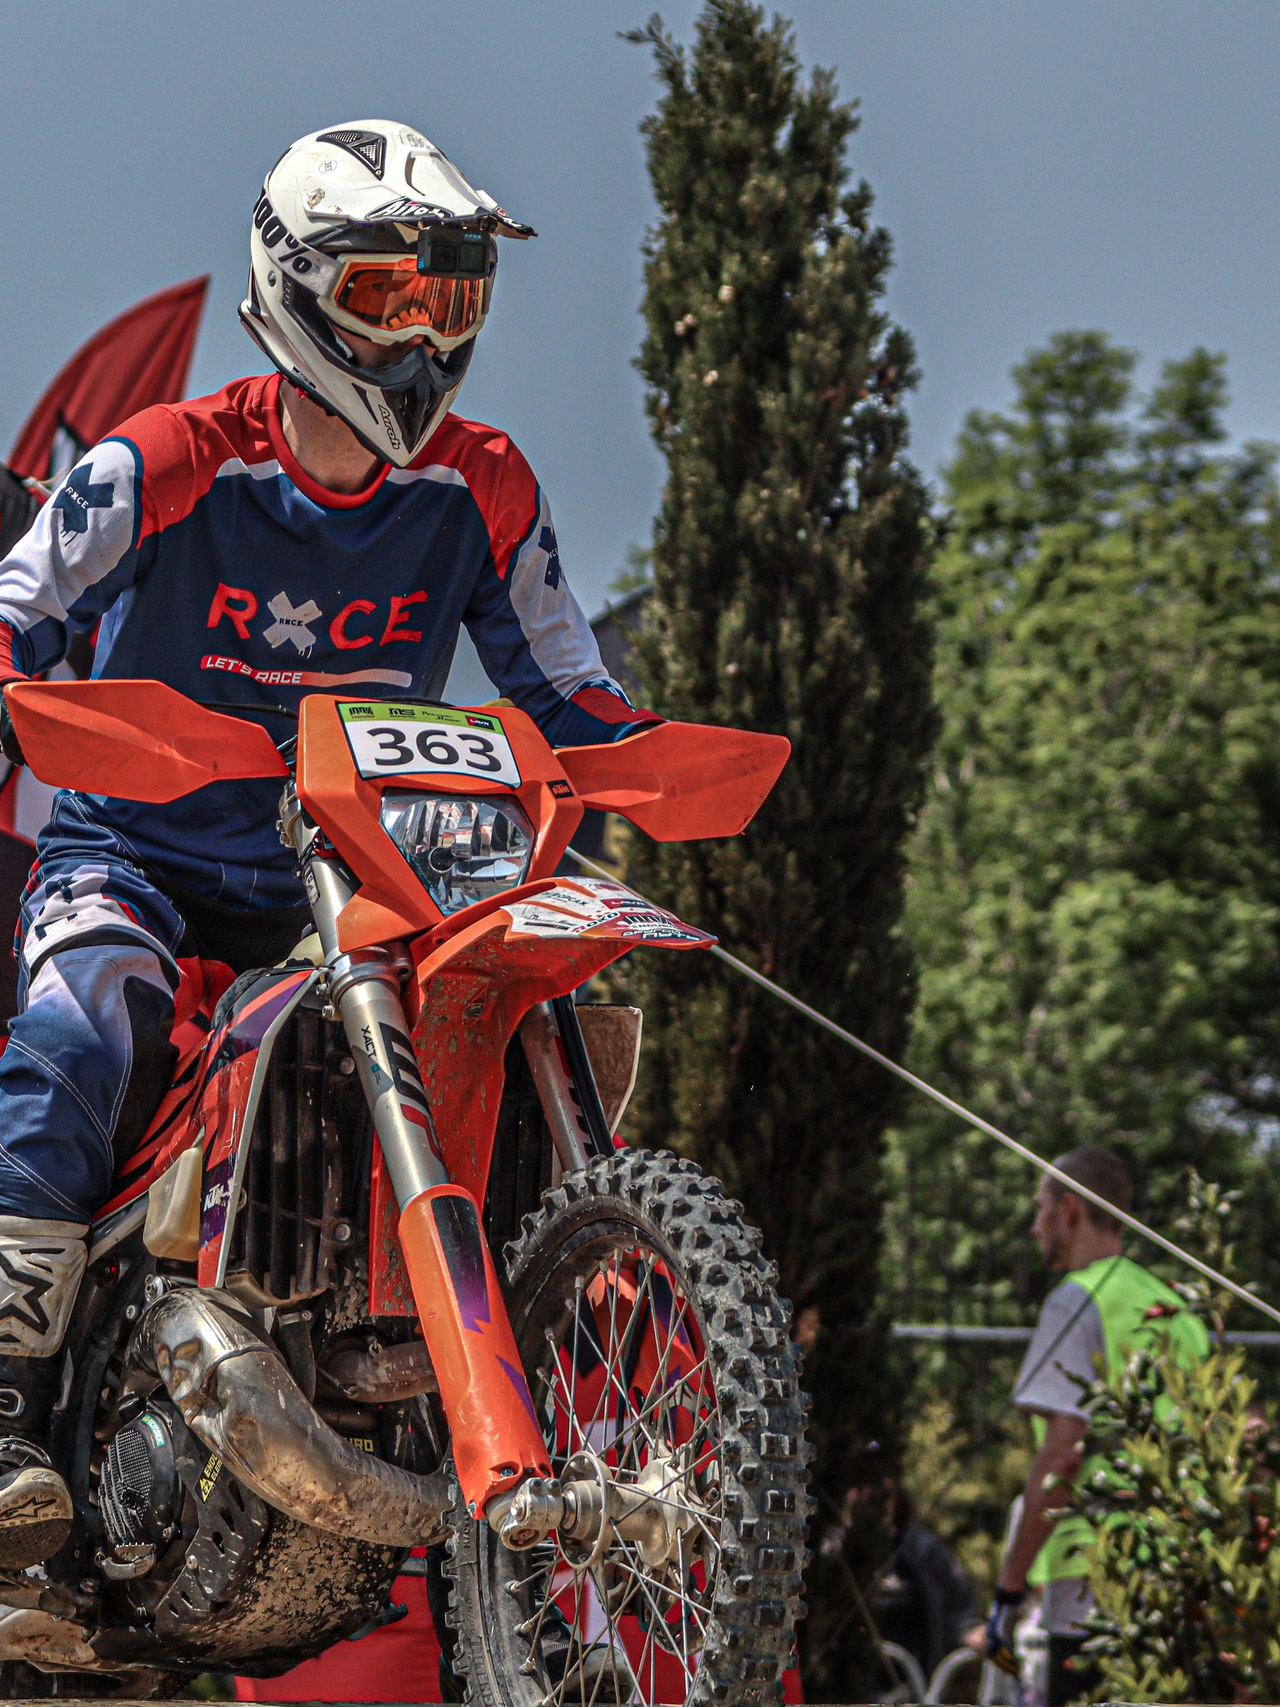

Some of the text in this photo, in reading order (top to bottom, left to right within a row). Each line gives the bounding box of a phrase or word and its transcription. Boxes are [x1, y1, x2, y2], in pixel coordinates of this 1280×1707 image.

[206, 655, 304, 685] LET'S RACE
[366, 727, 502, 772] 363
[360, 1024, 377, 1059] XACT
